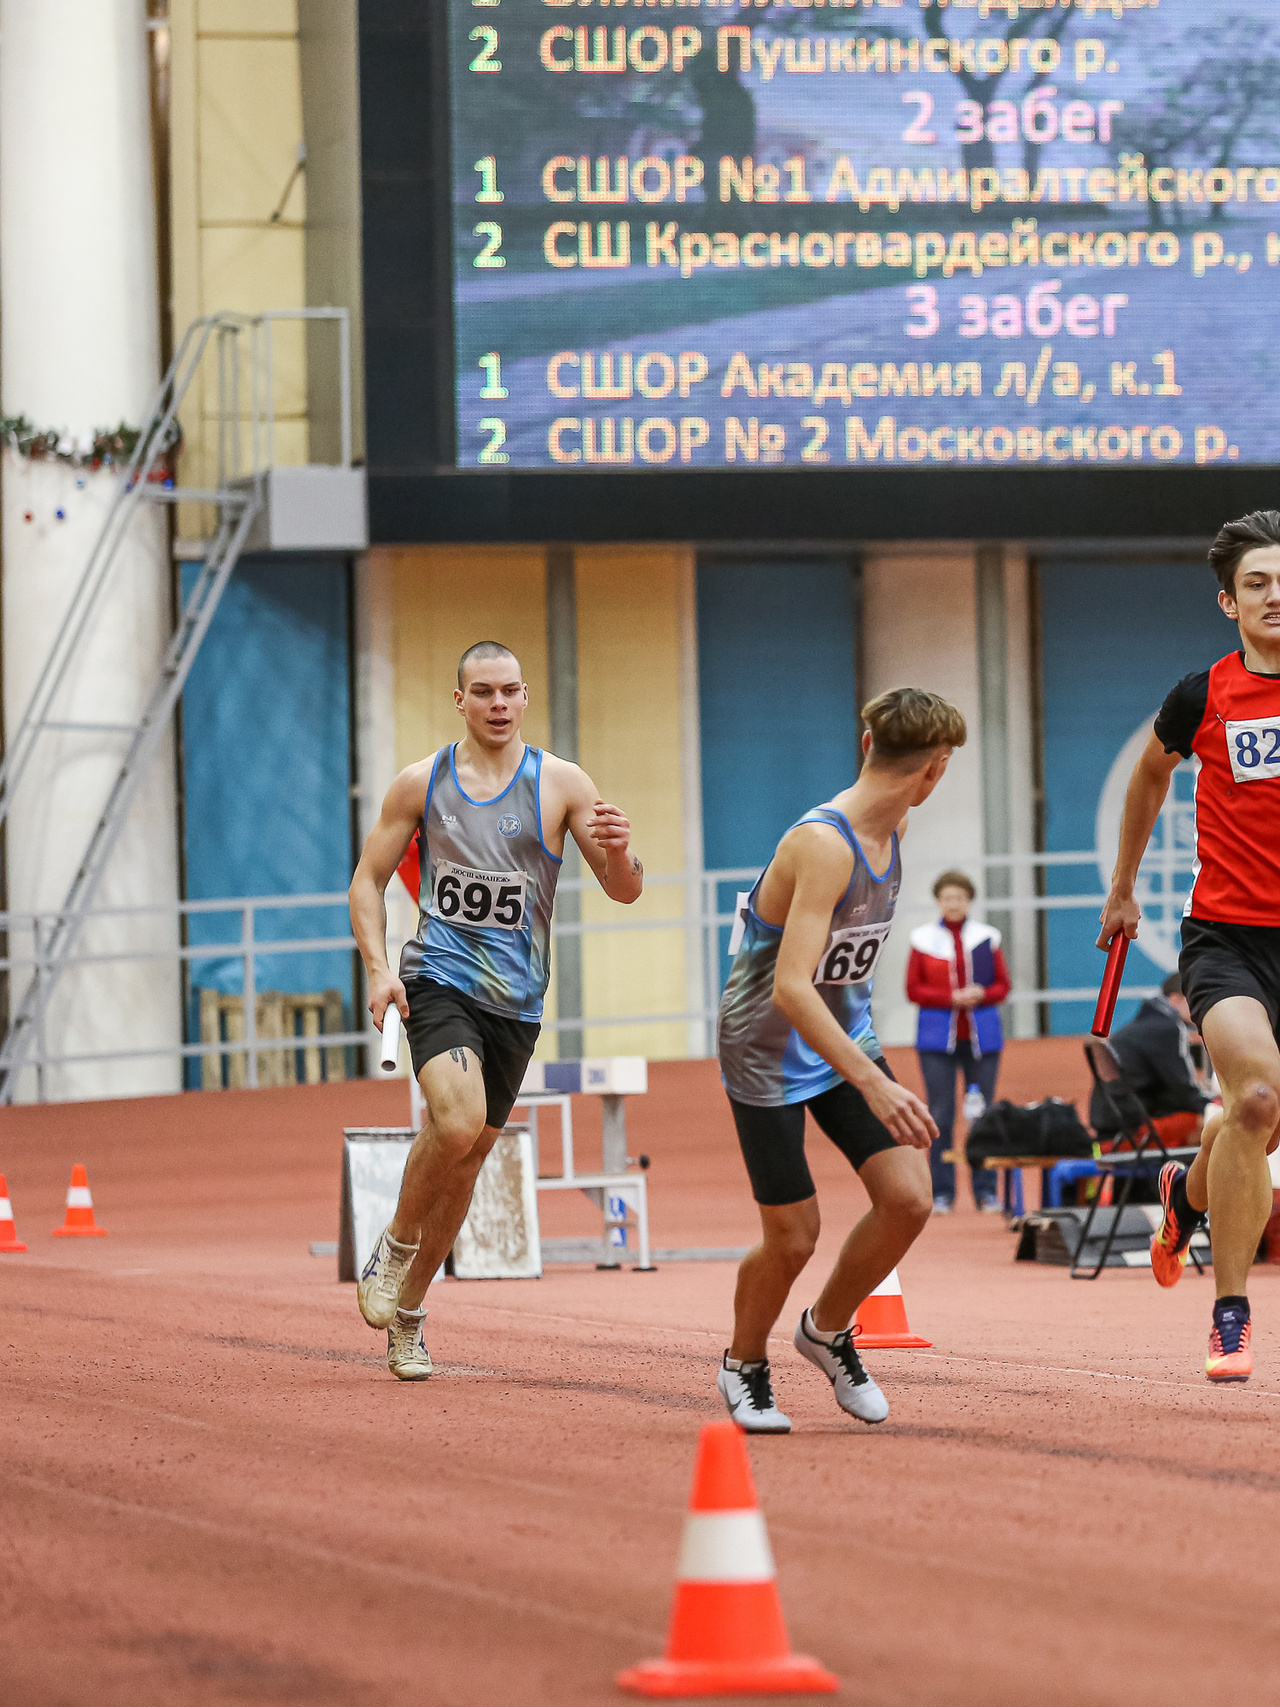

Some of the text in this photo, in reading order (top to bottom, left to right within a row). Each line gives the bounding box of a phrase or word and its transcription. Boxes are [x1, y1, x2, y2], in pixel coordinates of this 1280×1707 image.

[469, 25, 1120, 83] 2 СШОР Пушкинского р.
[901, 85, 1124, 144] 2 забег
[474, 155, 505, 203] 1
[542, 155, 704, 203] СШОР
[719, 155, 812, 203] №1
[473, 221, 506, 268] 2
[544, 221, 630, 268] СШ
[645, 217, 1180, 278] Красногвардейского
[1192, 231, 1253, 278] р.,
[905, 279, 1129, 338] 3 забег
[479, 344, 1182, 407] 1 СШОР Академия л/а, к.1
[477, 415, 1240, 466] 2 СШОР № 2 Московского р.
[437, 874, 522, 926] 695
